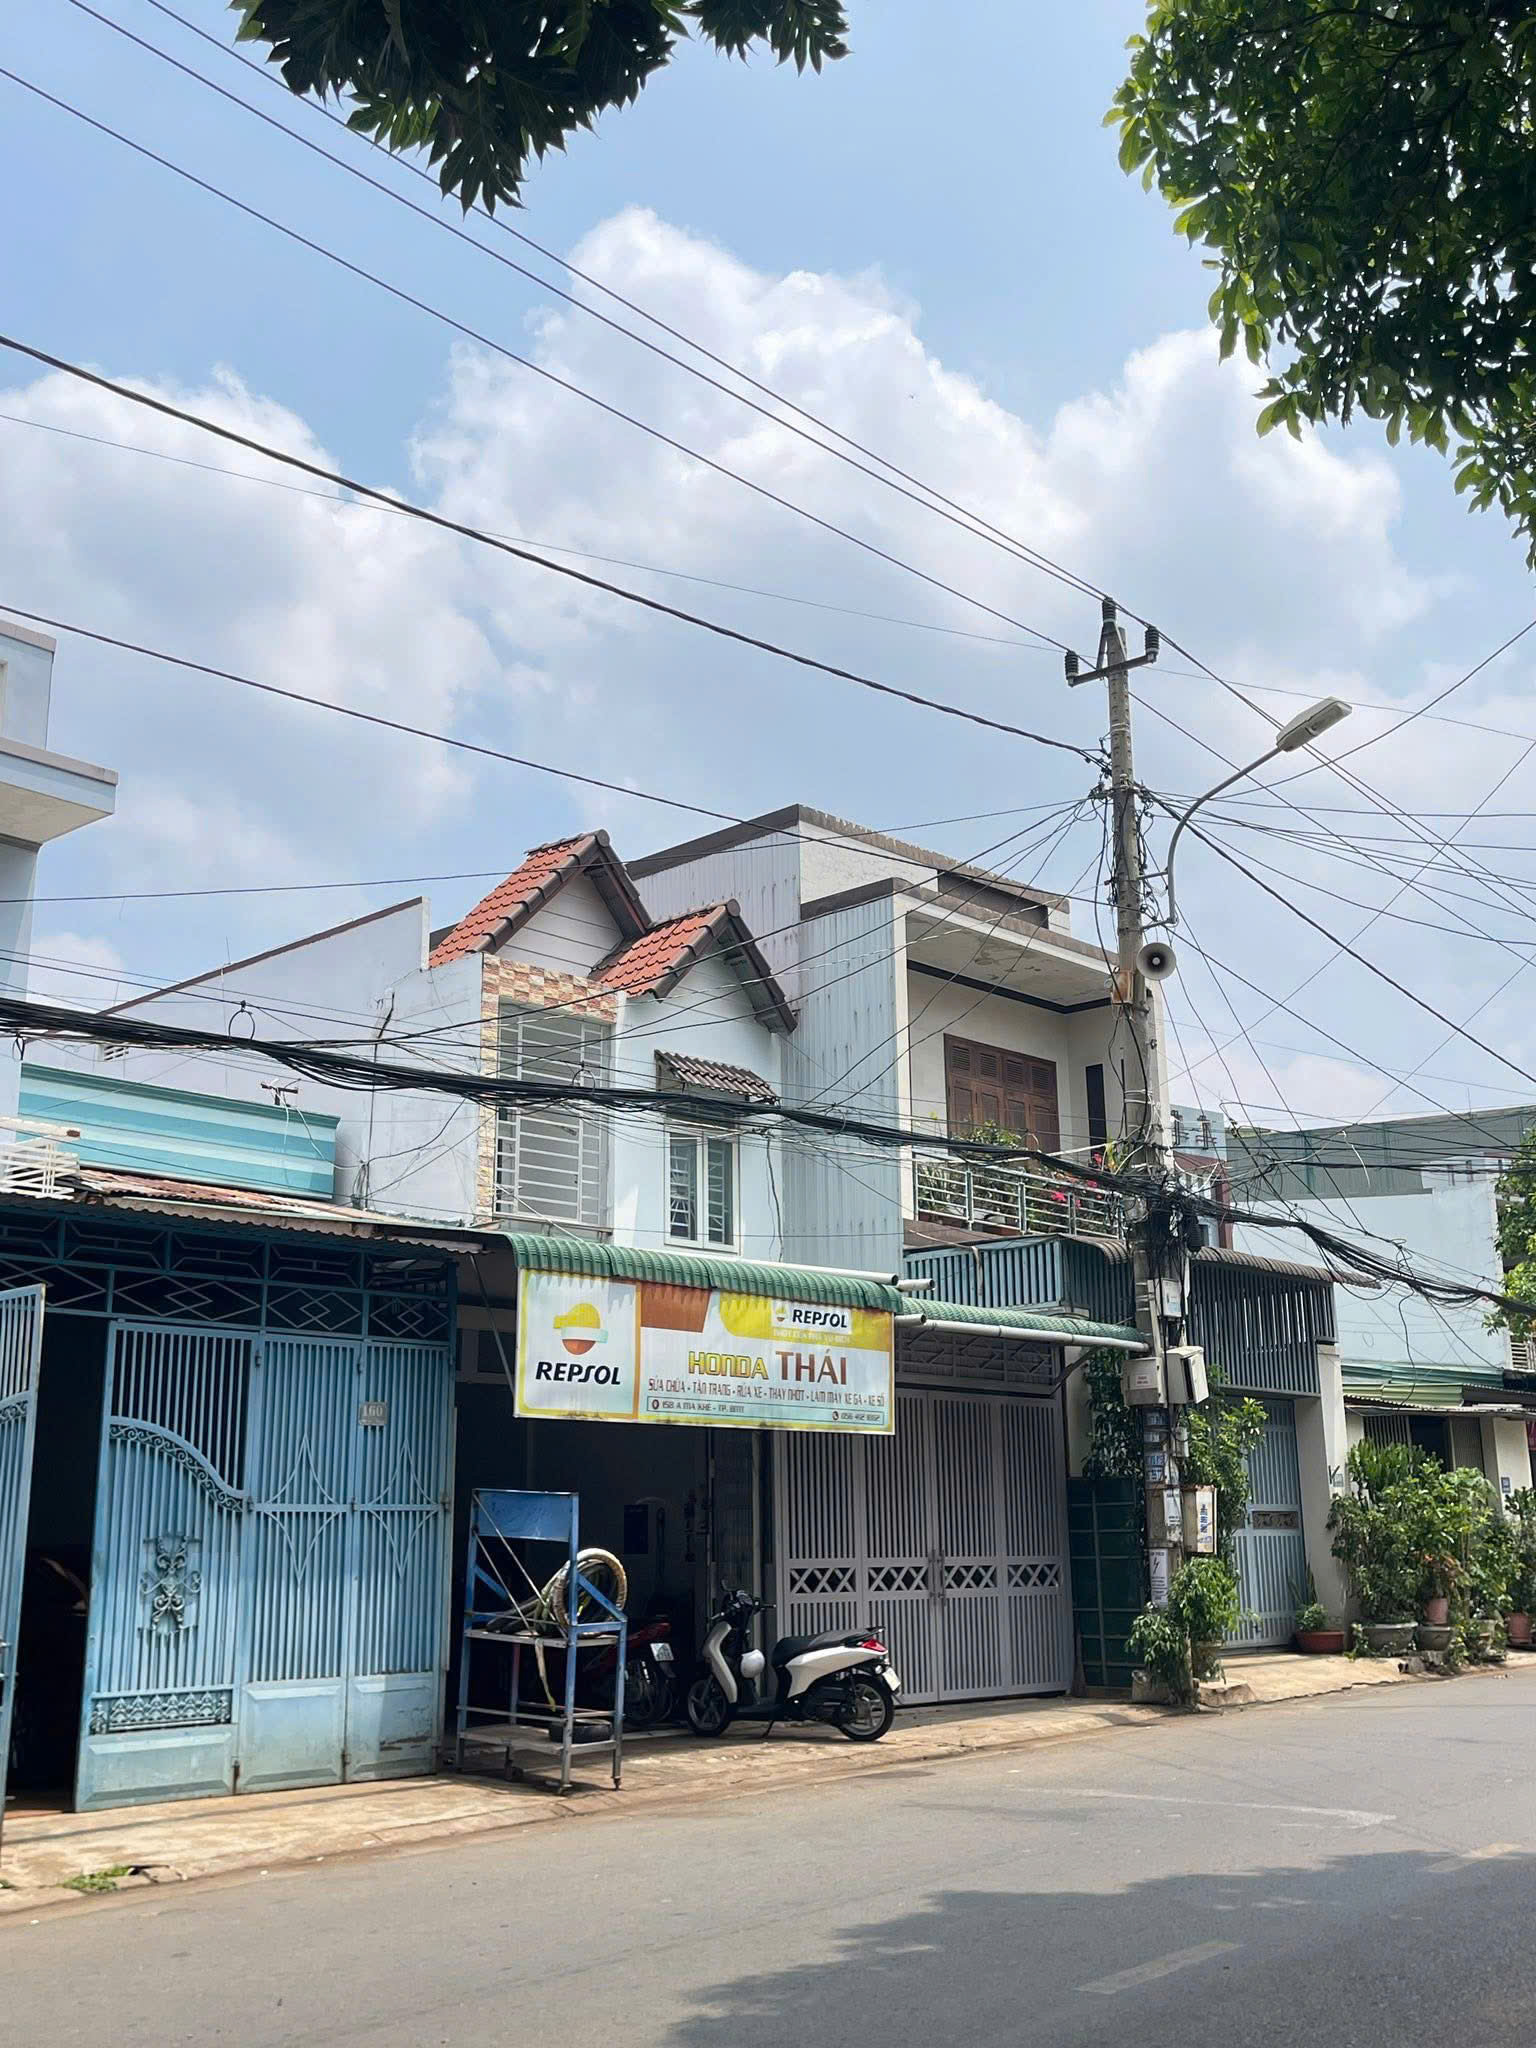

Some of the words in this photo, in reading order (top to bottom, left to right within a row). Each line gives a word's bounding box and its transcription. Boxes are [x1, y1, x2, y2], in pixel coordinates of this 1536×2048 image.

[792, 1309, 848, 1328] REPSOL
[535, 1361, 621, 1385] REPSOL
[688, 1350, 769, 1380] HONDA
[775, 1348, 848, 1385] THÁI
